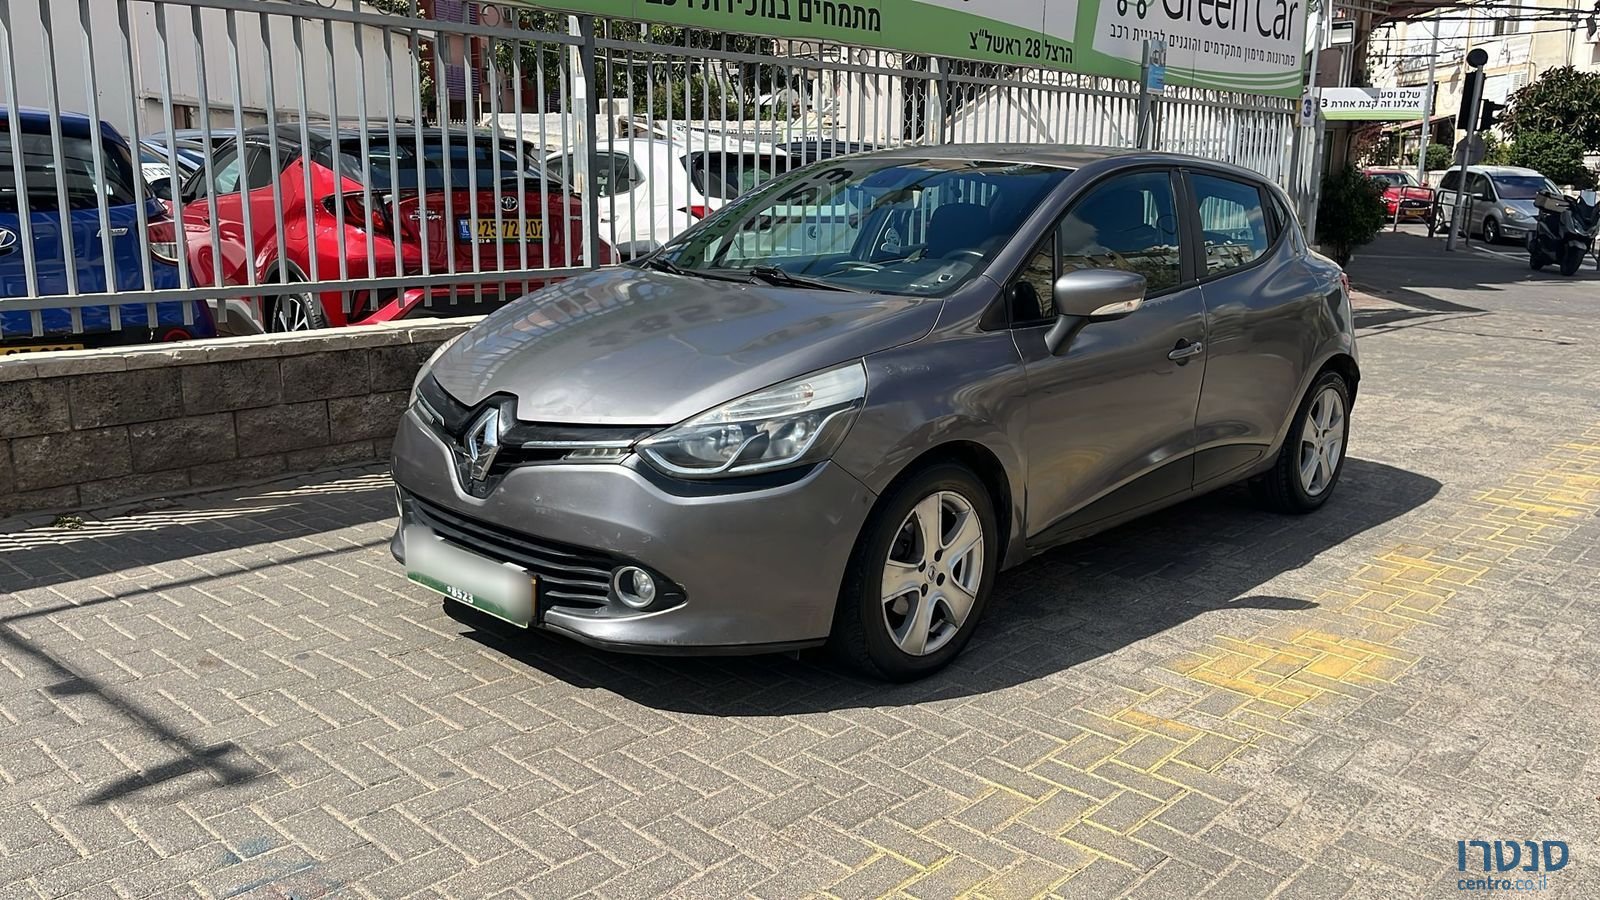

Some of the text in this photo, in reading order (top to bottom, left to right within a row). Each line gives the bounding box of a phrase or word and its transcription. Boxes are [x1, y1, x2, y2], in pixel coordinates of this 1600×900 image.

[799, 0, 880, 32] מתמחים
[1256, 0, 1298, 40] Car
[1110, 24, 1128, 39] רכב
[1025, 37, 1040, 58] 28
[1169, 34, 1201, 51] והוגנים
[1204, 41, 1242, 59] מתקדמים
[1044, 39, 1073, 63] הרצל
[1244, 47, 1264, 62] מימון
[1266, 51, 1295, 66] פתרונות
[1399, 89, 1420, 99] שלם
[1358, 101, 1377, 109] קצת
[1394, 99, 1419, 108] אצלנו
